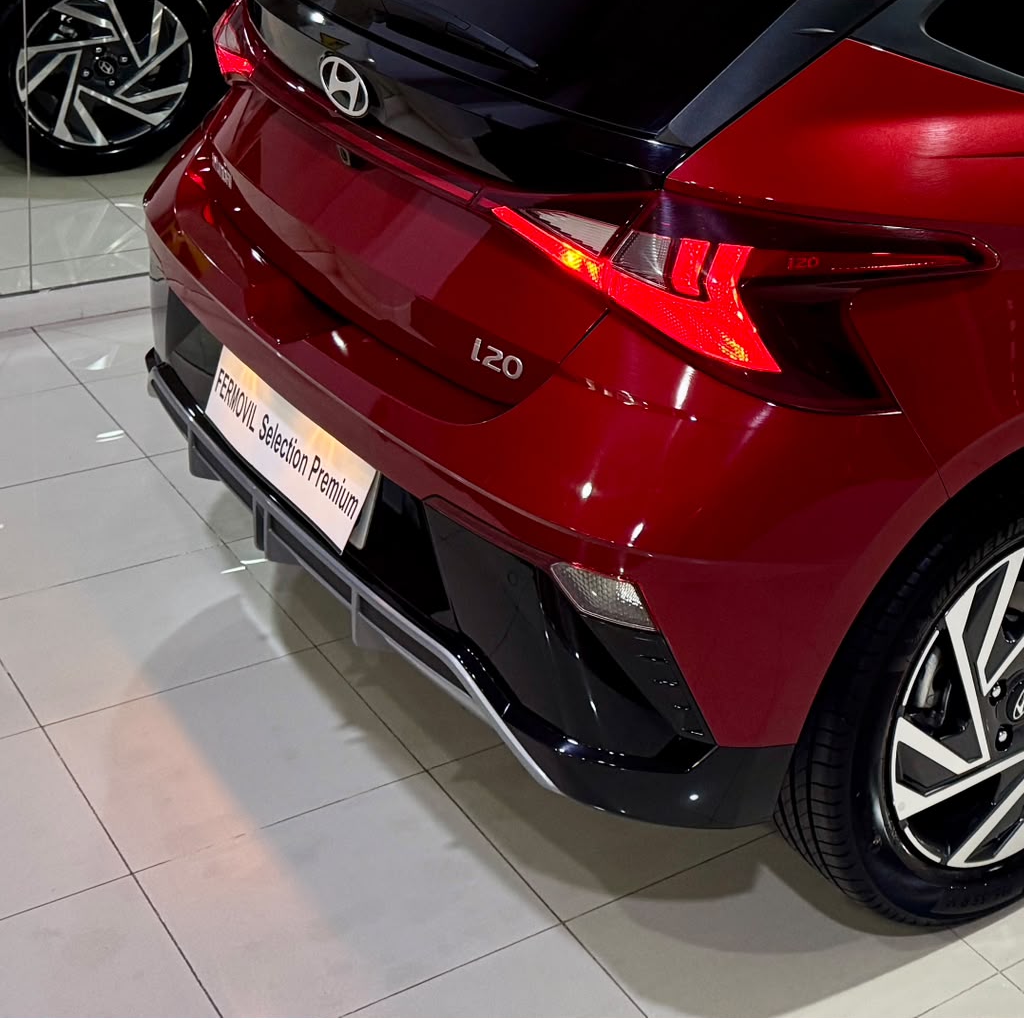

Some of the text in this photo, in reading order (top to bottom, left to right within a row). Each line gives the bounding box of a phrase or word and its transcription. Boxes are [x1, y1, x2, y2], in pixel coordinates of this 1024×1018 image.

[214, 367, 360, 521] FERMOVIL Selection Premium
